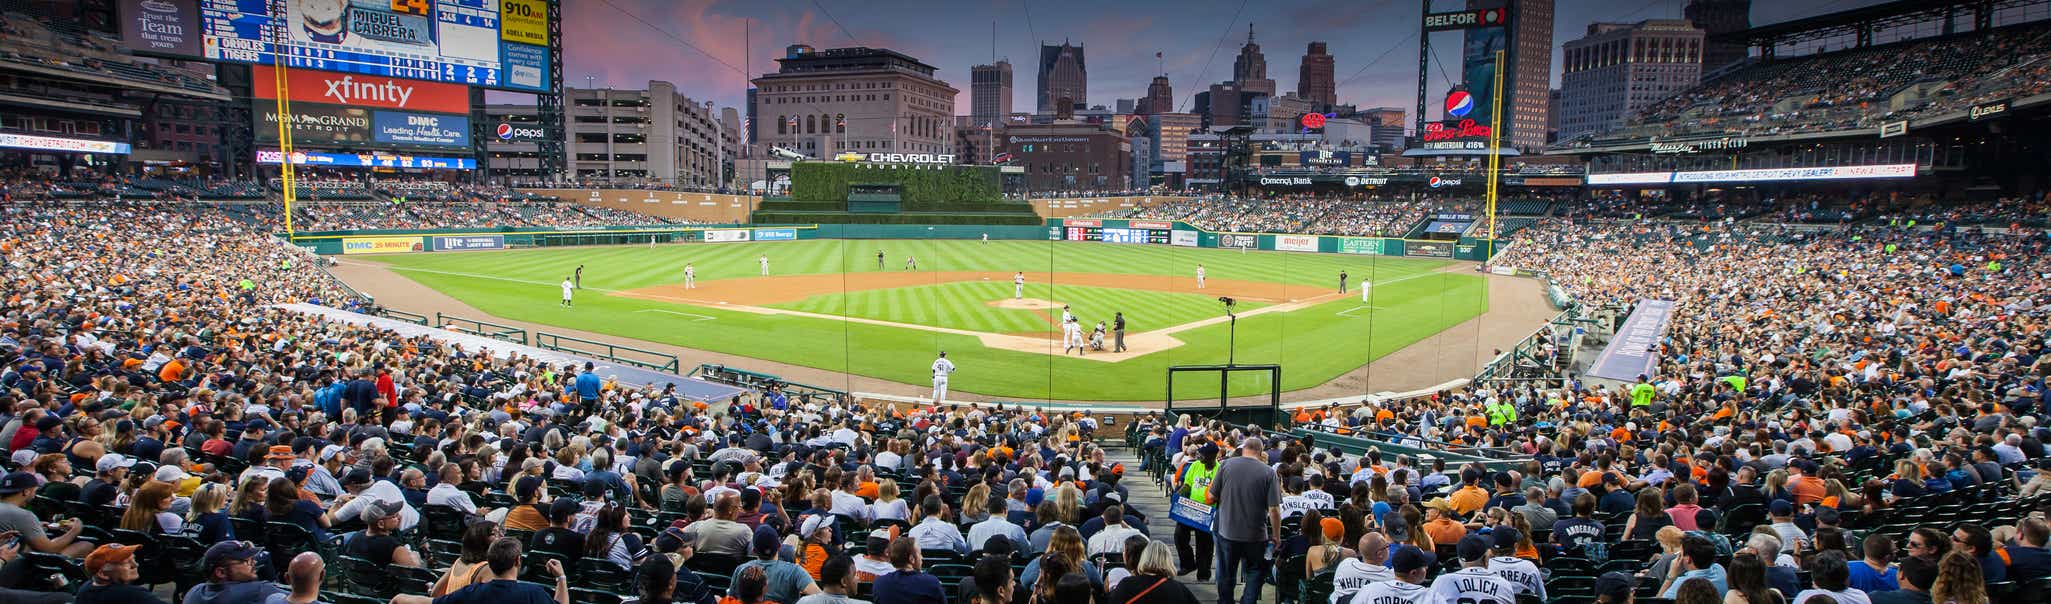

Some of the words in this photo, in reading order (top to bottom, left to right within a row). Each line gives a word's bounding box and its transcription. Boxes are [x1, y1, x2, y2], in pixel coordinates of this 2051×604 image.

[505, 2, 531, 17] 910
[353, 10, 403, 26] MIGUEL
[1425, 12, 1477, 28] BELFOR
[137, 17, 183, 36] Team
[353, 21, 417, 40] CABRERA
[141, 32, 158, 41] that
[160, 34, 183, 43] treats
[222, 37, 265, 52] ORIOLES
[223, 50, 260, 62] TIGERS
[324, 76, 413, 107] xfinity
[320, 115, 367, 127] GRAND
[407, 116, 438, 127] DMC
[286, 124, 350, 133] DETROIT
[514, 127, 544, 138] pepsi
[870, 152, 955, 164] CHEVROLET
[1294, 177, 1312, 185] Bank
[1360, 177, 1388, 185] DETROIT
[1441, 179, 1462, 187] pepsi
[346, 242, 373, 250] DMC
[445, 237, 463, 249] Lite
[1284, 237, 1309, 247] meijer
[1343, 239, 1380, 249] EASTERN
[1565, 524, 1600, 537] ANDERSON
[1454, 577, 1499, 596] LOLICH
